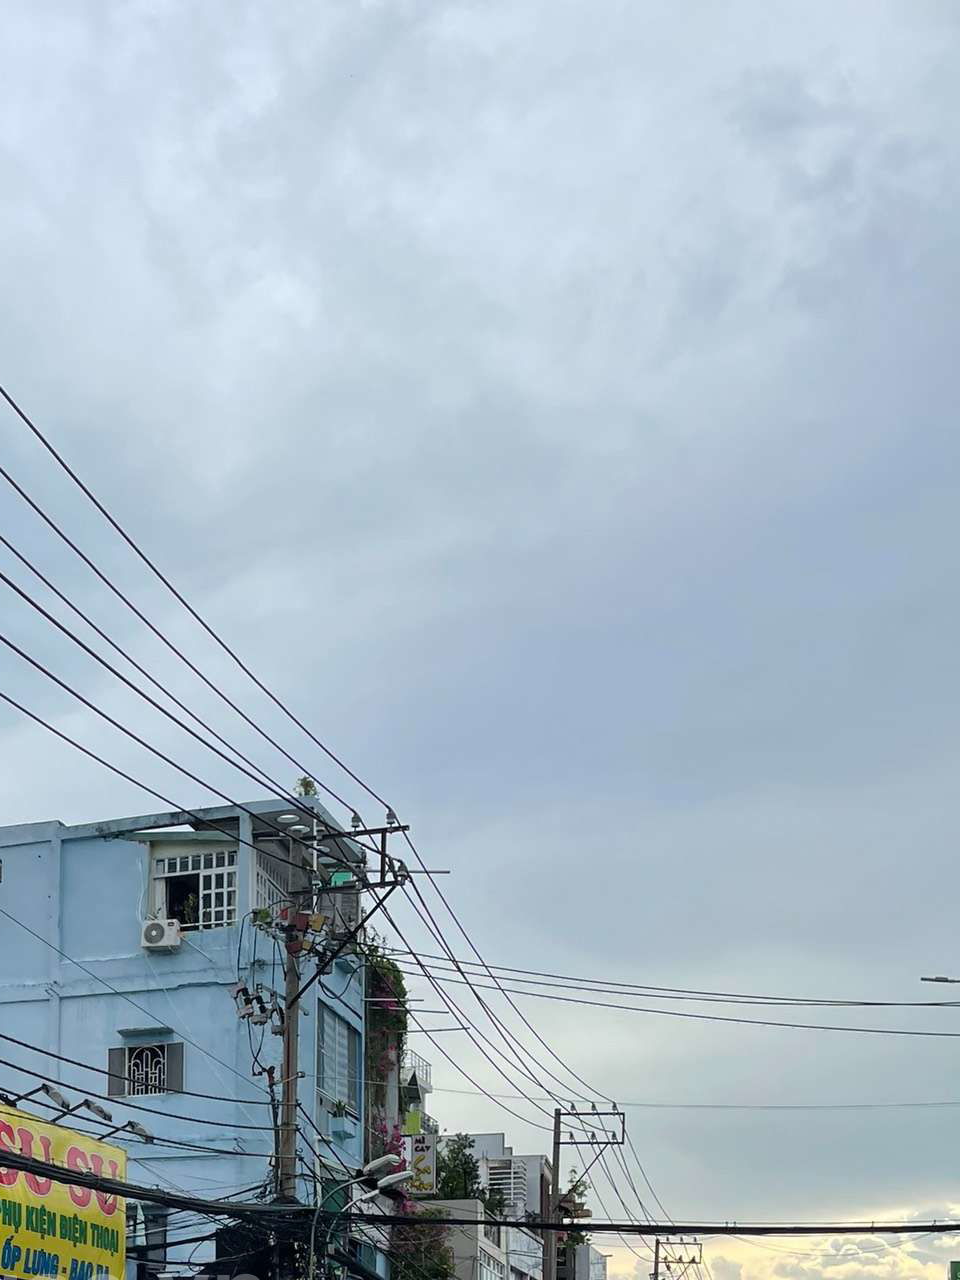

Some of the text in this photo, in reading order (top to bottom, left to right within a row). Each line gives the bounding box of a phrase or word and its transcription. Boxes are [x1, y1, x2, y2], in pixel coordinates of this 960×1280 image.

[25, 1204, 57, 1240] KIỆN
[59, 1213, 88, 1248] ĐIỆN
[90, 1223, 119, 1257] THOẠI
[0, 1235, 22, 1271] ỐP
